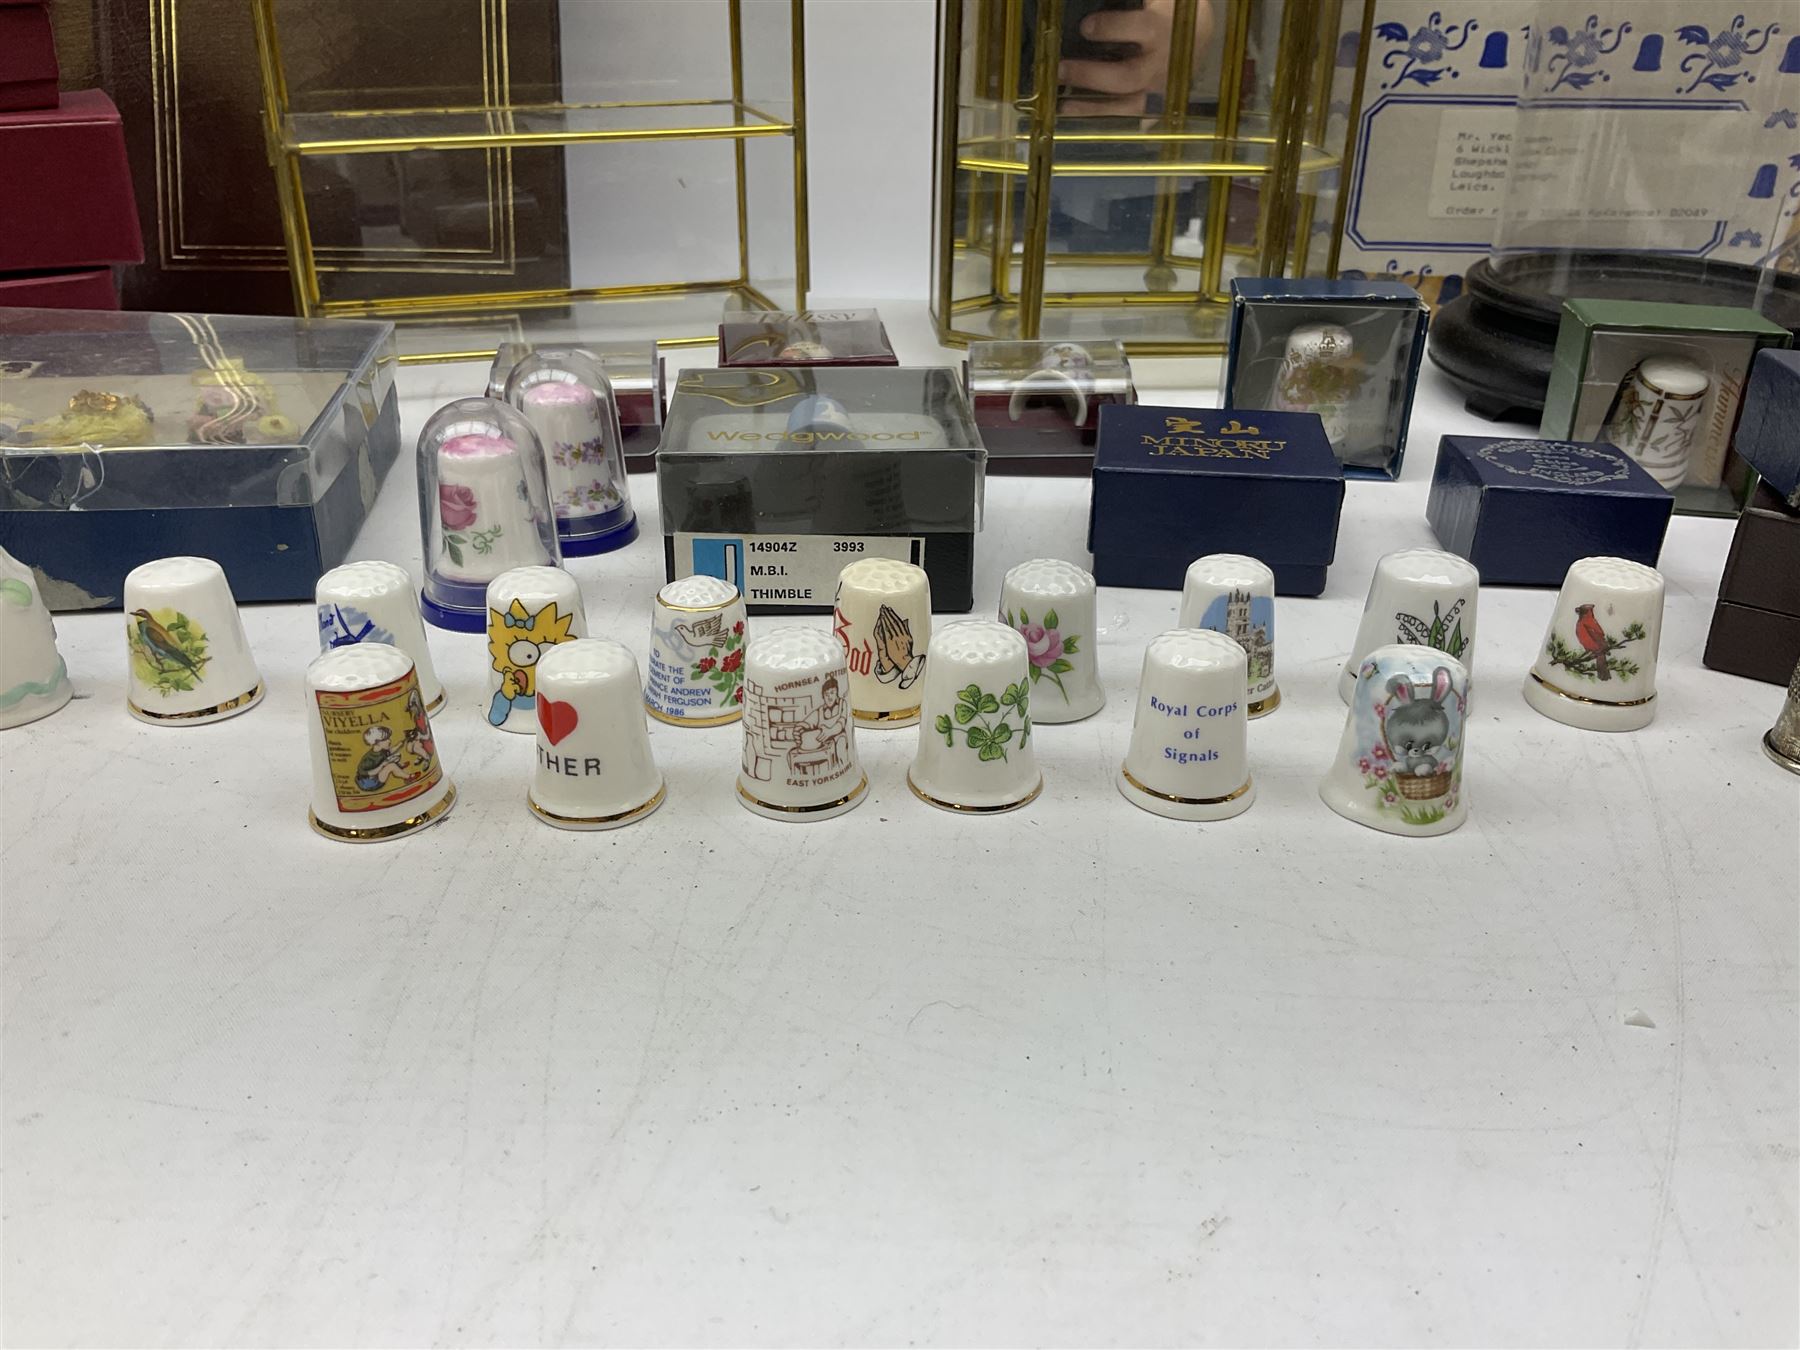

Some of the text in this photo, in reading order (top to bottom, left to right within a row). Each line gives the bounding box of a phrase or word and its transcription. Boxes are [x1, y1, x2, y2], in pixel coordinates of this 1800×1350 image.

[1140, 435, 1288, 451] MINORU
[1148, 445, 1271, 460] JAPAN
[749, 541, 865, 553] 14904Z 3993
[750, 565, 788, 576] M.B.I.
[750, 588, 813, 599] THIMBLE
[668, 665, 684, 675] THE
[673, 676, 685, 685] OF
[774, 676, 820, 692] HORNSEA
[671, 687, 711, 696] ANDREW
[664, 694, 712, 706] FERGUSON
[666, 706, 685, 716] 1986
[1150, 696, 1238, 718] Royal Corps
[323, 711, 390, 728] VIYELLA
[1183, 727, 1201, 740] of
[1164, 747, 1219, 765] Signals
[786, 778, 809, 787] EAST
